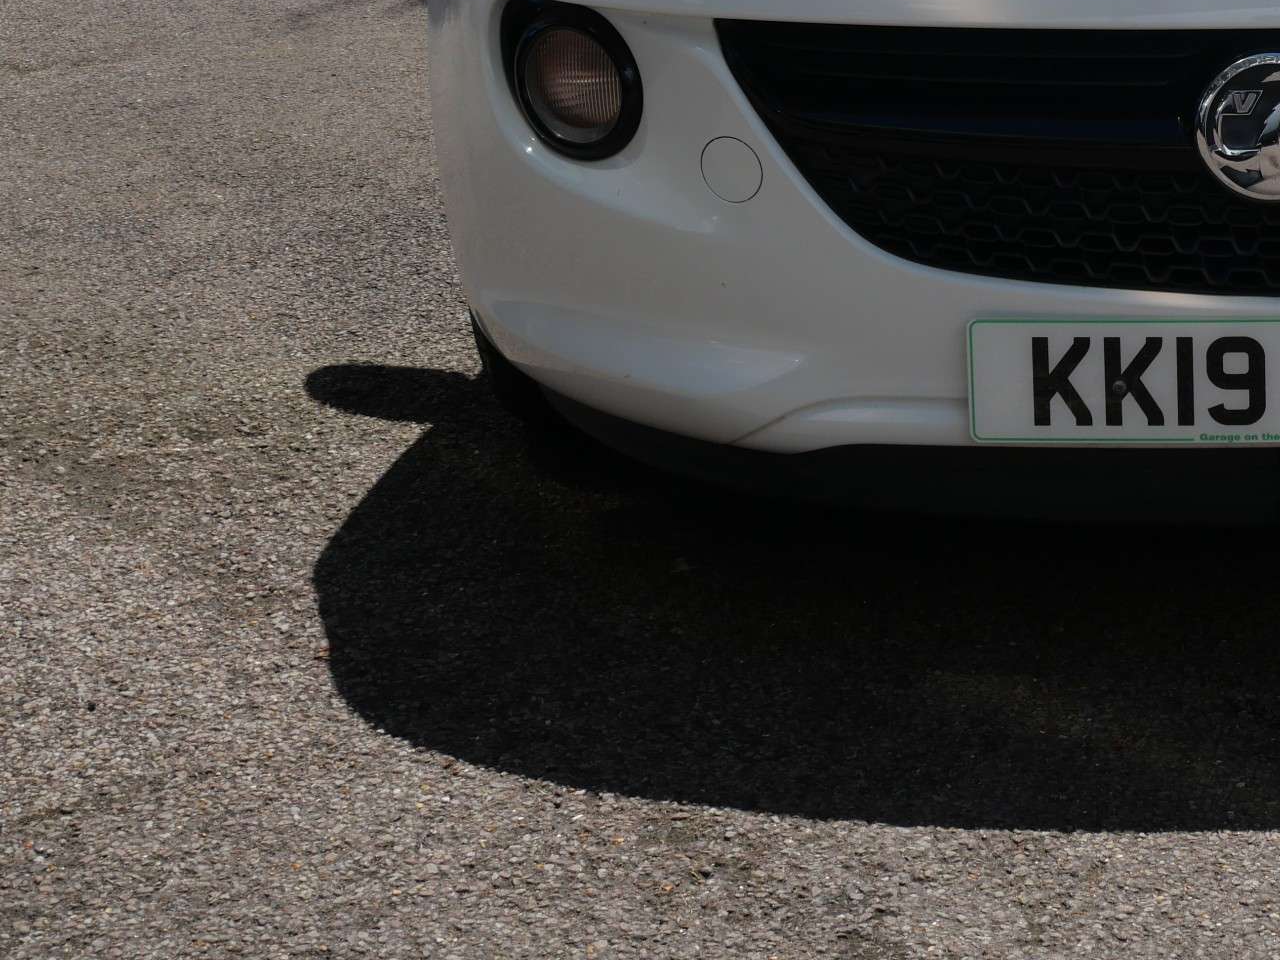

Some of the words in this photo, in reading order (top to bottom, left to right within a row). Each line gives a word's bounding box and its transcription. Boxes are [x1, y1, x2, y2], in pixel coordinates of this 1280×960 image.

[1032, 336, 1266, 426] KK19
[1199, 432, 1240, 442] Garage
[1262, 432, 1280, 441] the
